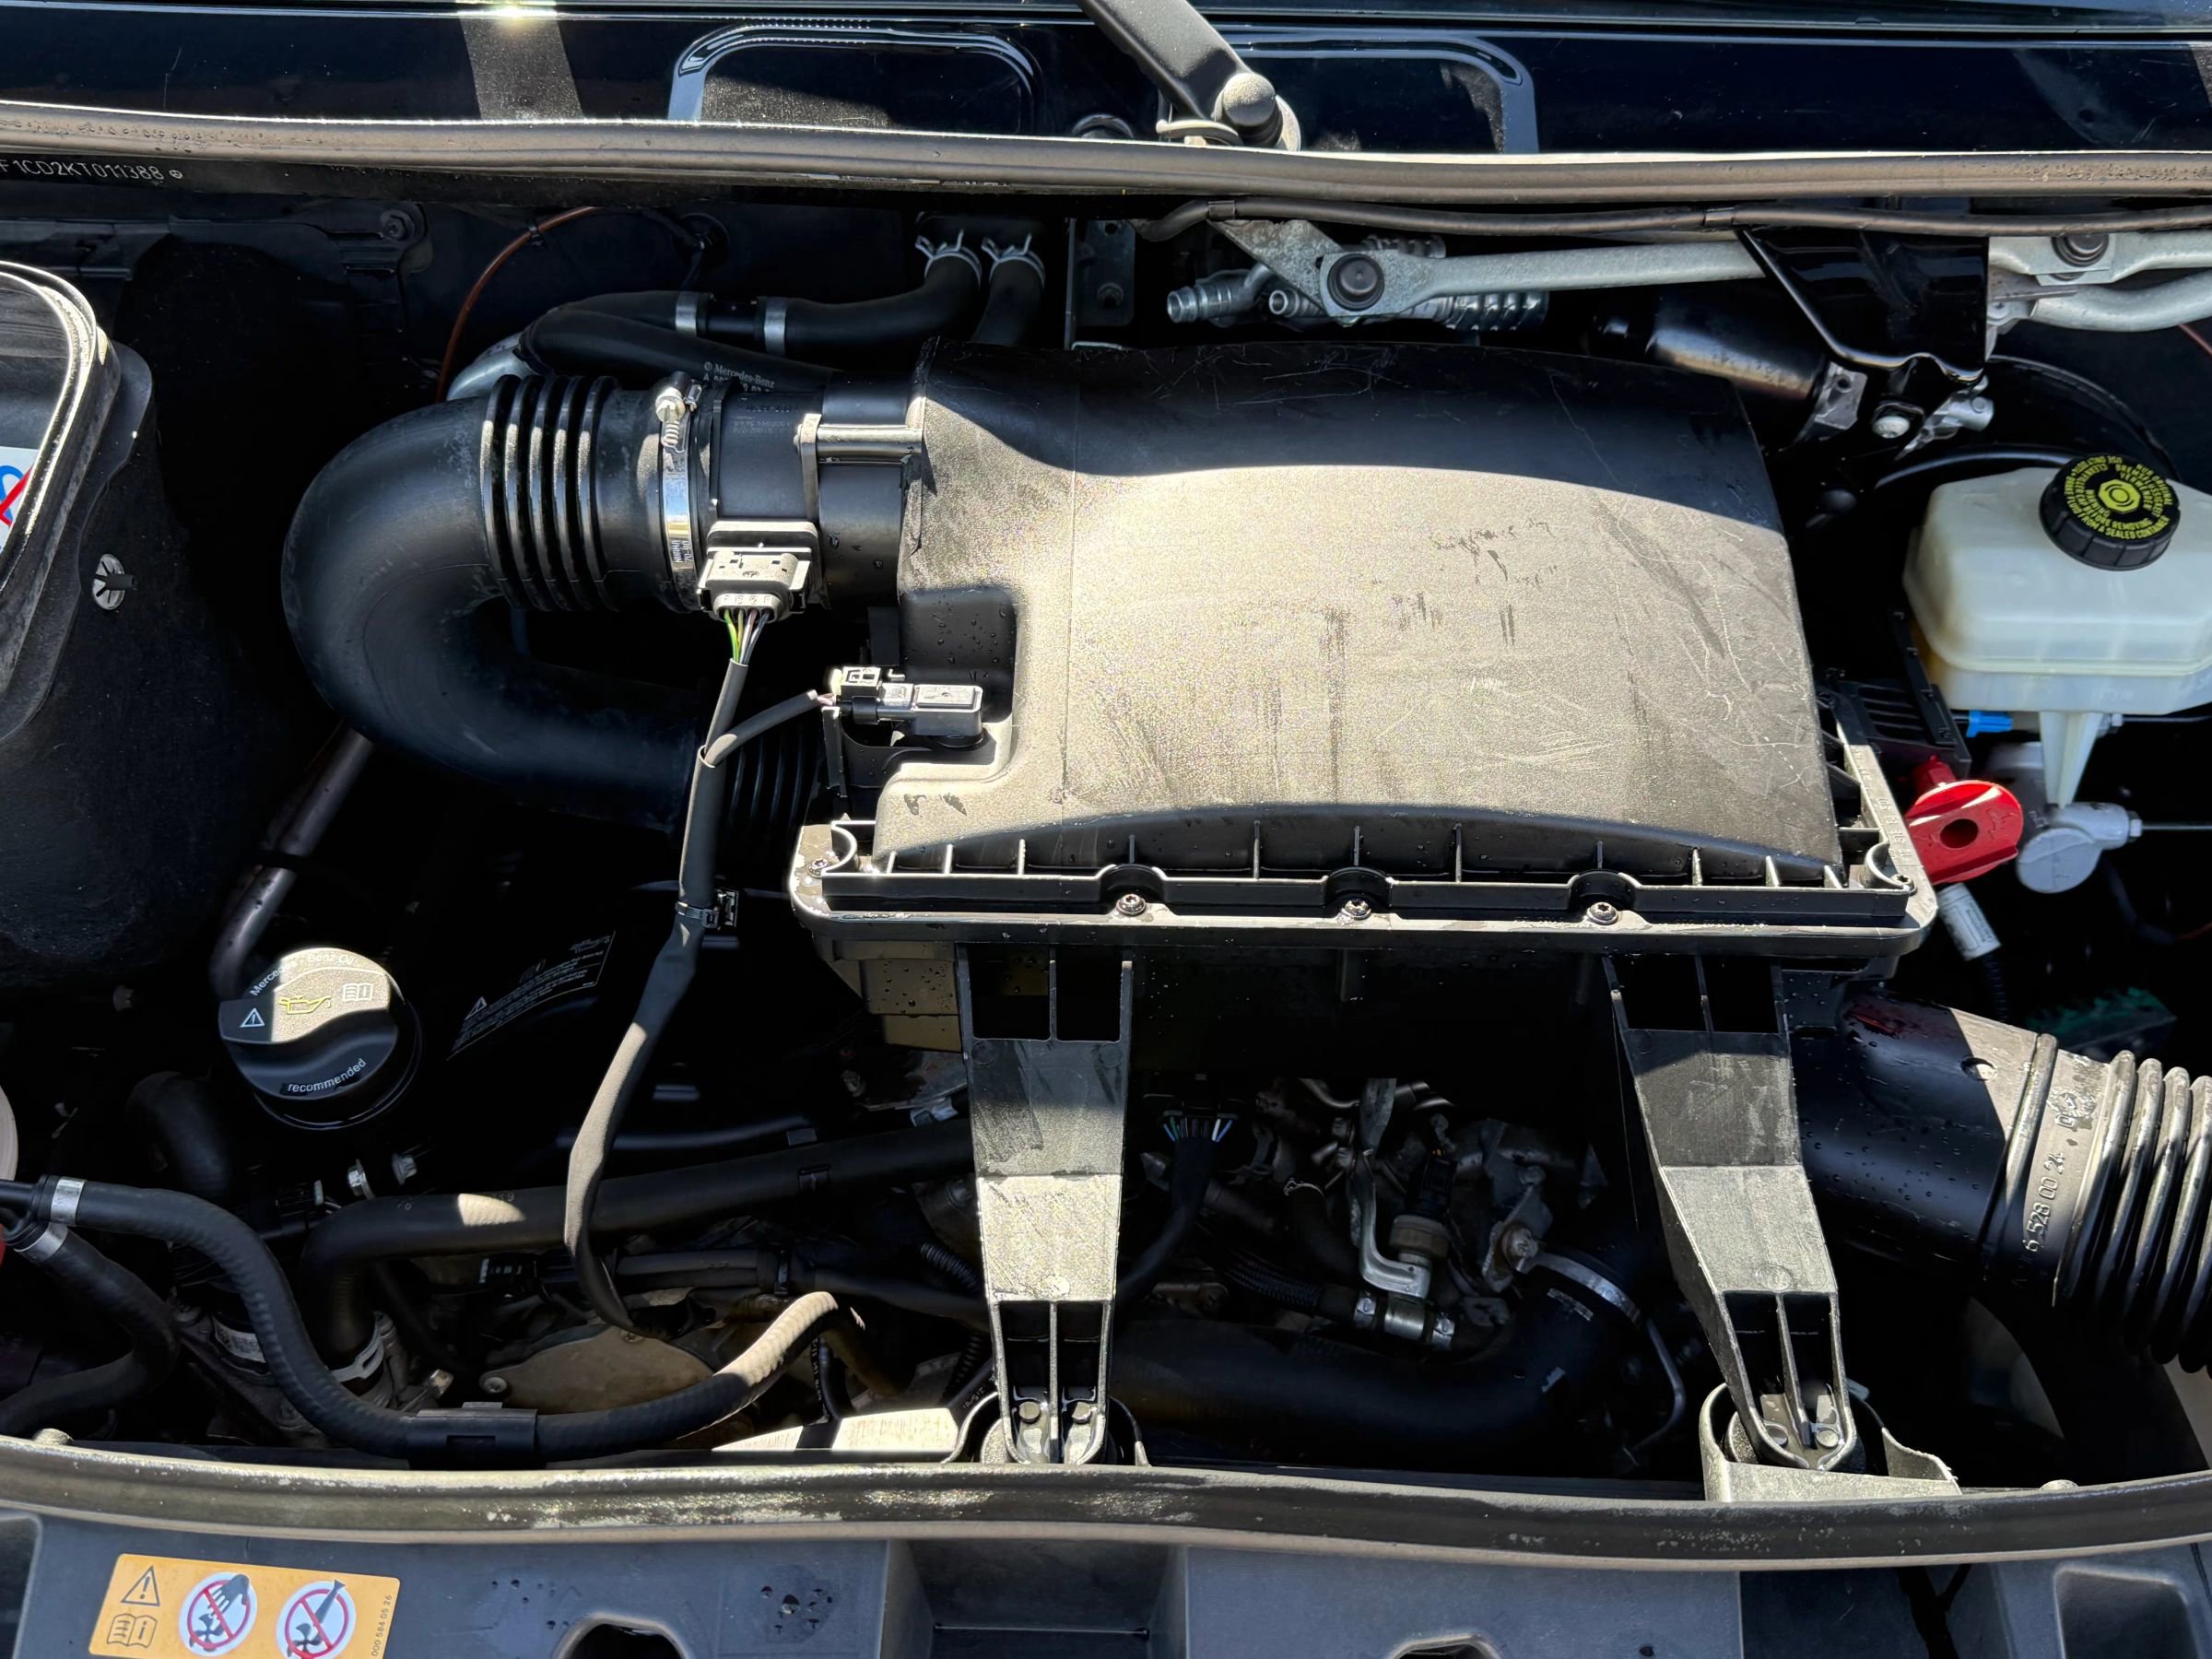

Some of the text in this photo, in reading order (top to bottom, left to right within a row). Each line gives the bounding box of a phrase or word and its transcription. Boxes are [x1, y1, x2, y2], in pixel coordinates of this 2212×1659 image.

[714, 363, 775, 389] Mercedes-Benz
[2104, 527, 2136, 539] SEALED
[288, 1057, 367, 1092] recommended
[2038, 1176, 2058, 1200] 00
[2026, 1202, 2051, 1236] 528
[382, 1594, 393, 1606] 26
[380, 1607, 389, 1619] 05
[371, 1639, 382, 1657] 000
